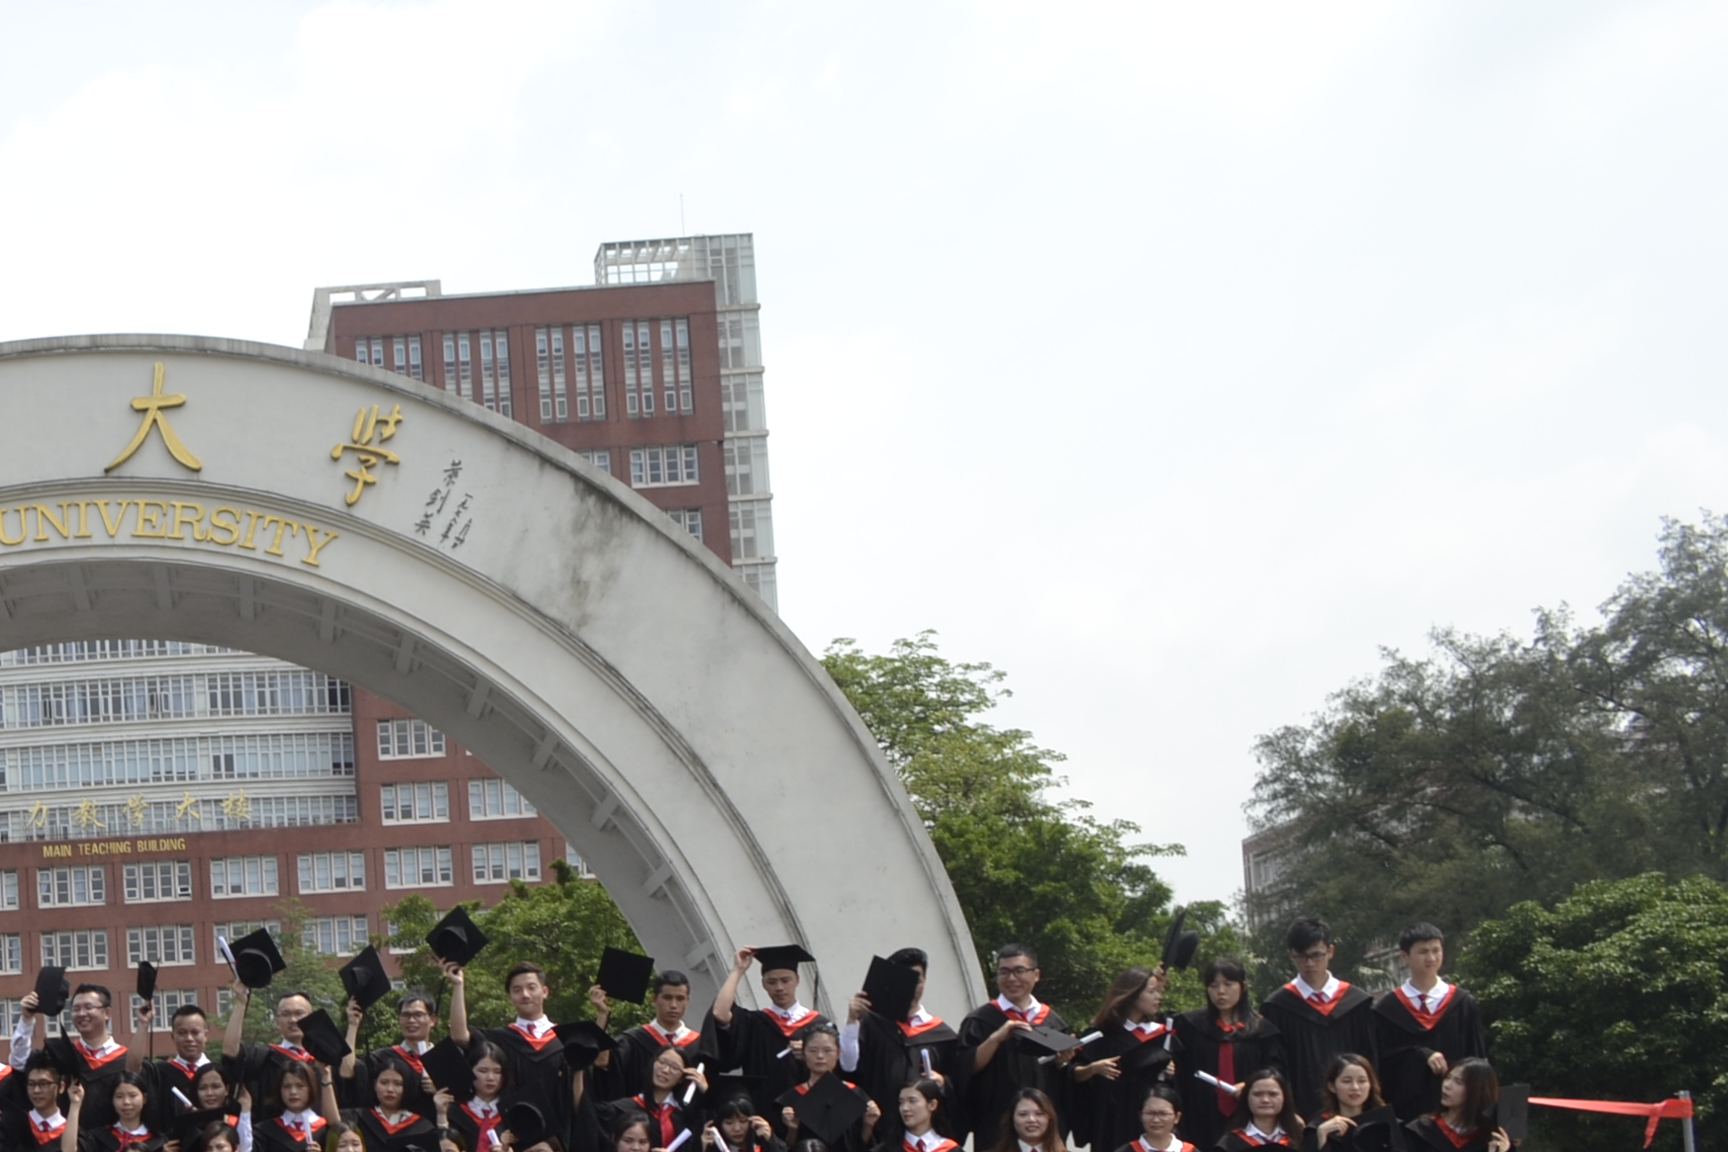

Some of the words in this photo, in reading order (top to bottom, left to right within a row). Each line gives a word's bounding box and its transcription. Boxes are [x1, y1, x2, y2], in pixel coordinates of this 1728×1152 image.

[43, 845, 72, 858] MAIN
[77, 842, 132, 856] TEACHING
[137, 838, 186, 853] BUILDING
